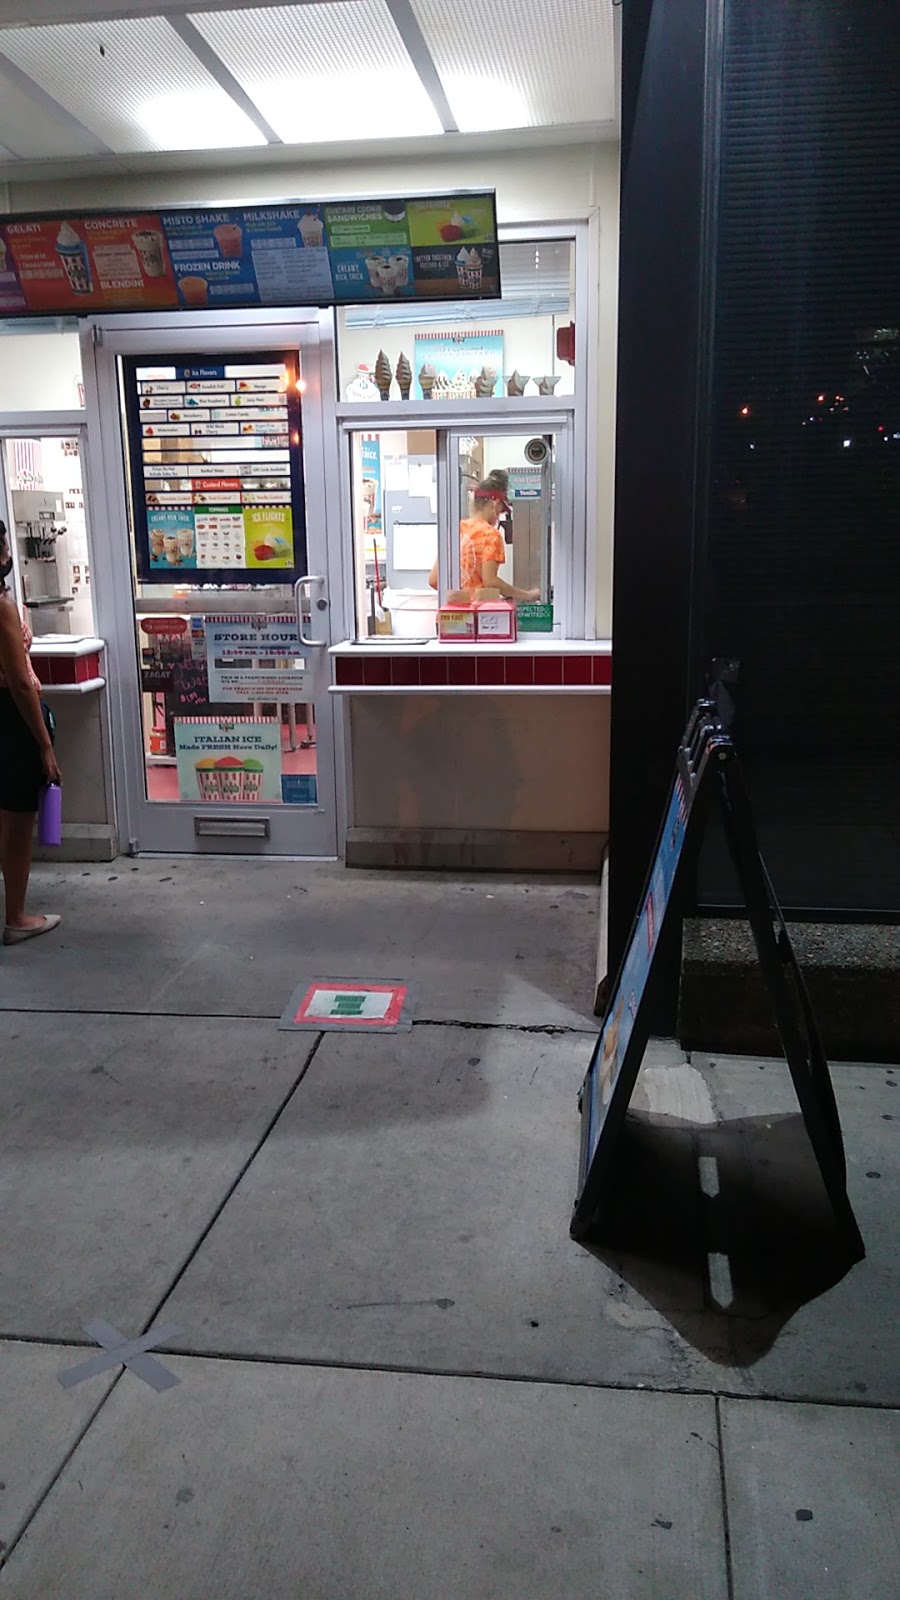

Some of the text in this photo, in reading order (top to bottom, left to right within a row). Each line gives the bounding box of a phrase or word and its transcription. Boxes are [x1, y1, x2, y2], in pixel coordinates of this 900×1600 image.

[162, 213, 230, 226] MISTO SHAKE
[243, 209, 300, 221] MILKSHAKE
[327, 213, 382, 222] SANDWICHES
[7, 224, 41, 234] GELATI
[84, 218, 138, 230] CONCRETE
[174, 260, 240, 272] FROZEN DRINK
[214, 633, 306, 641] STORE HOUR
[194, 736, 262, 744] ITALIAN ICE
